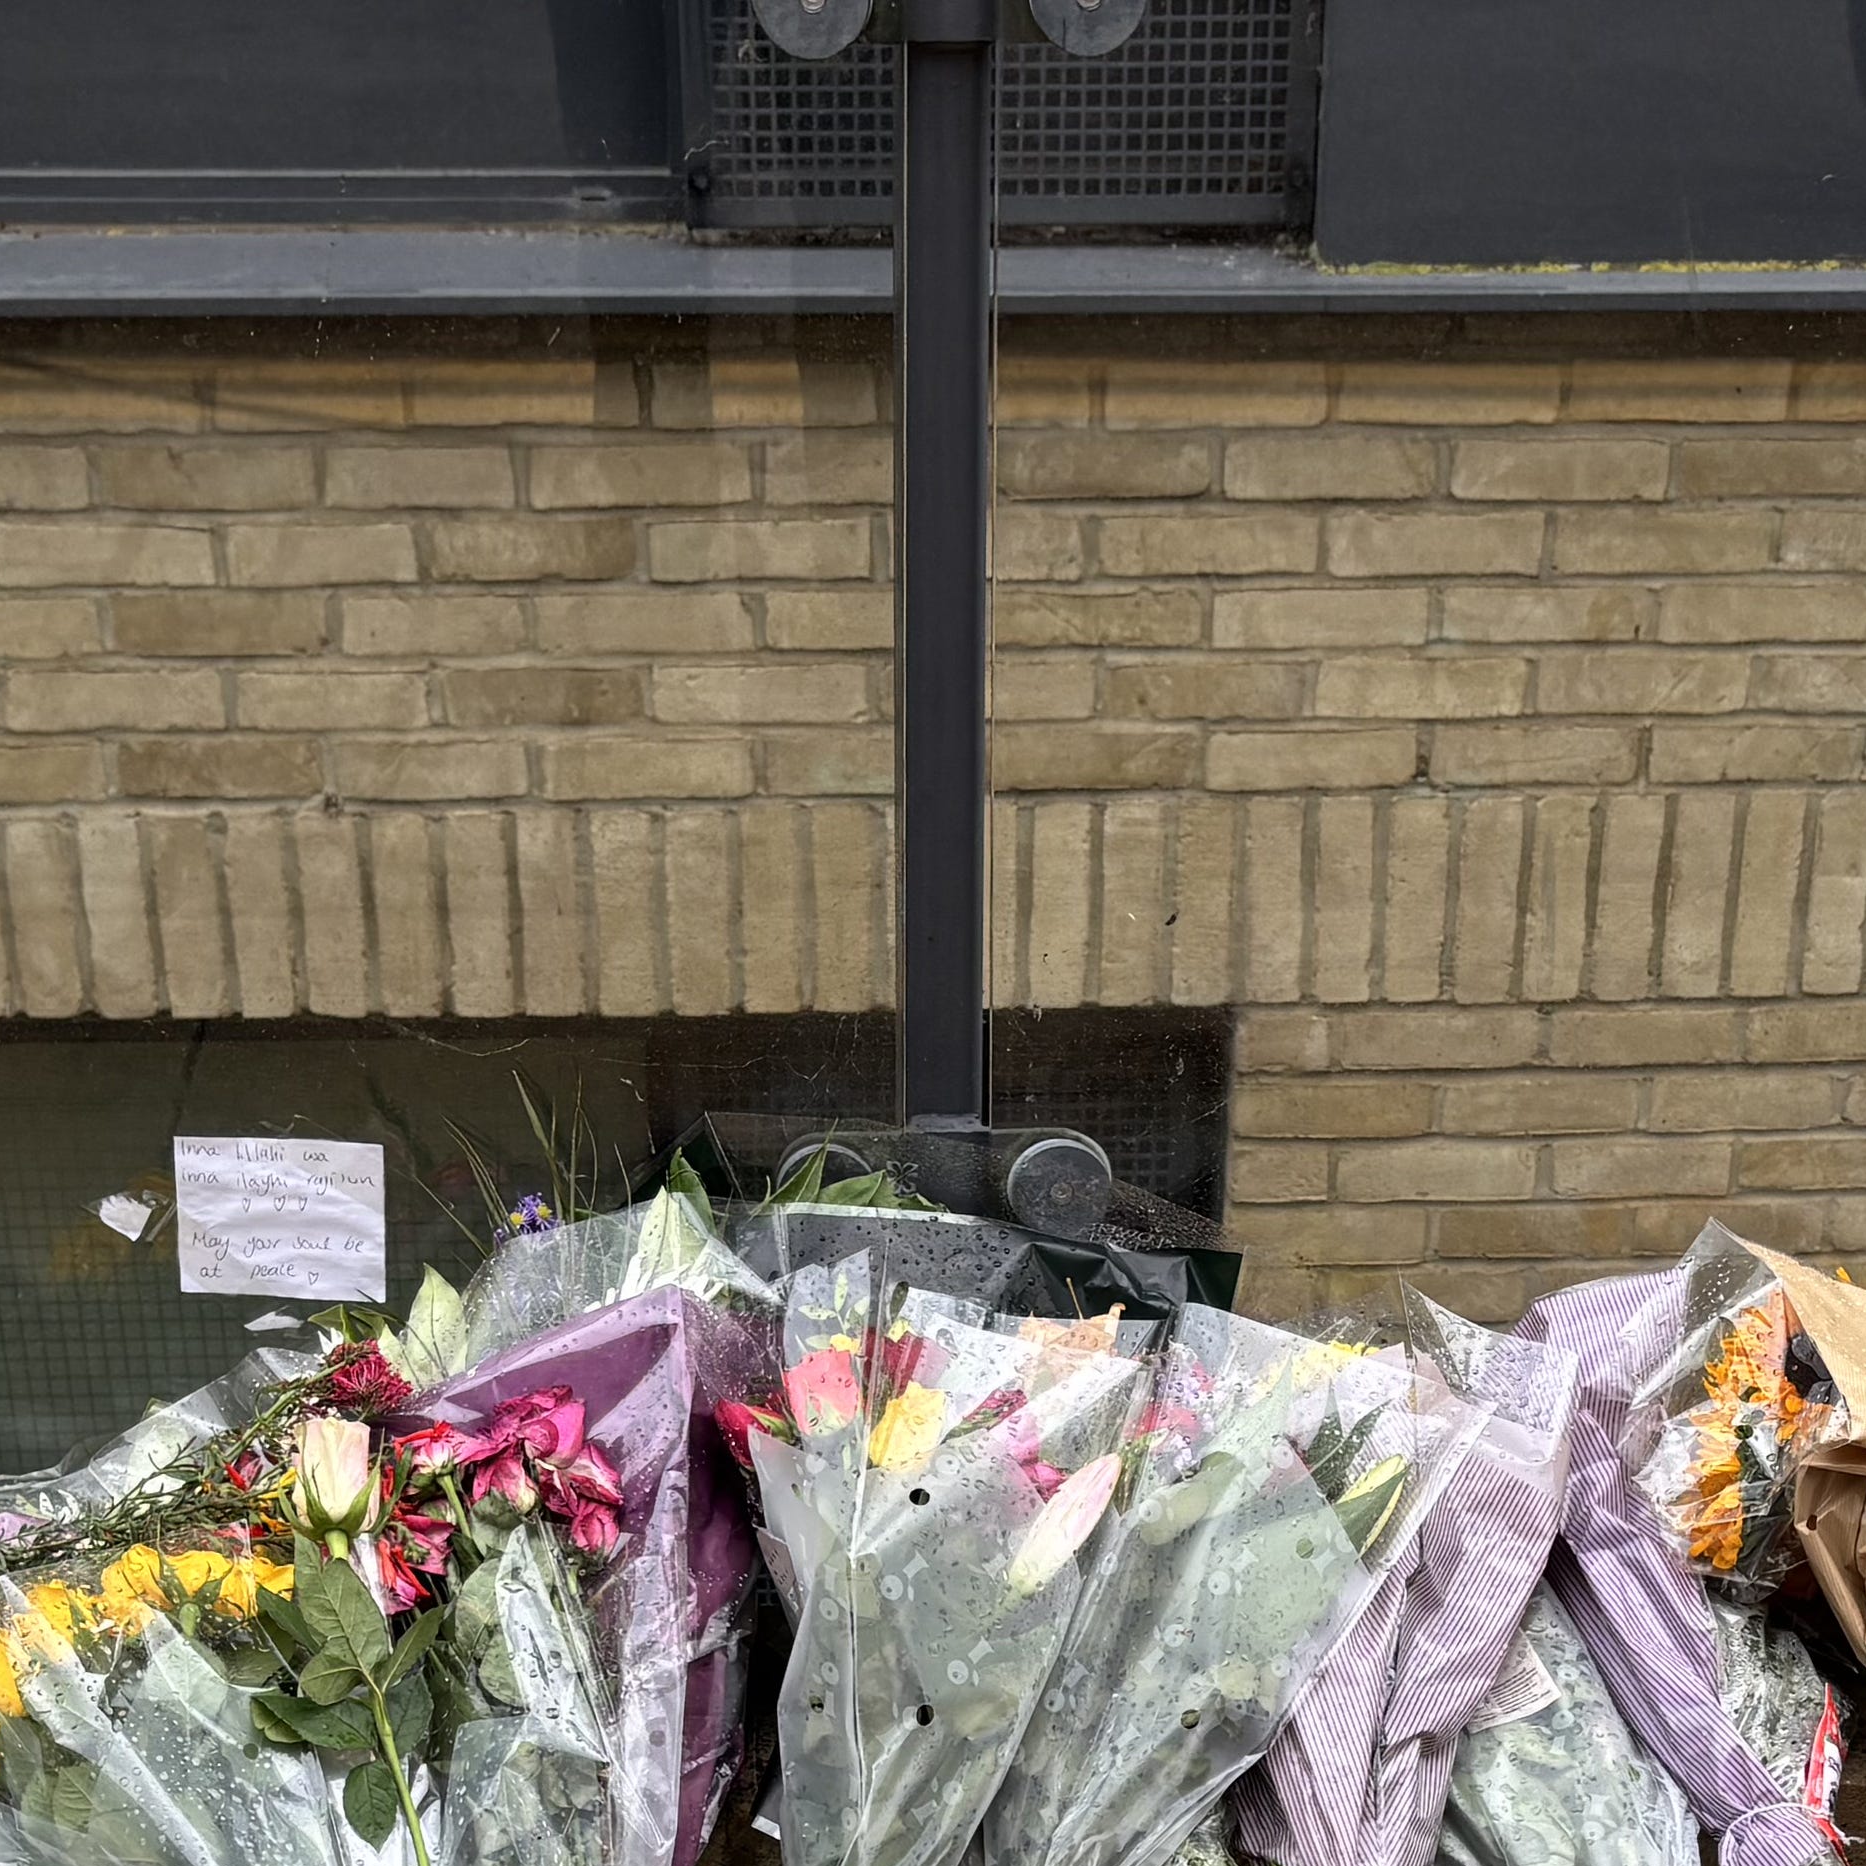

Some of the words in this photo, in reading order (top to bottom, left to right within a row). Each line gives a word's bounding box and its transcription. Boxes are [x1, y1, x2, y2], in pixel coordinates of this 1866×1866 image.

[181, 1140, 220, 1157] Inna
[181, 1167, 219, 1185] inna
[236, 1171, 288, 1197] ilayhi
[192, 1231, 230, 1261] May
[243, 1235, 282, 1258] your
[292, 1235, 331, 1251] soul
[343, 1235, 365, 1253] be
[199, 1263, 222, 1278] at
[250, 1262, 297, 1280] peace
